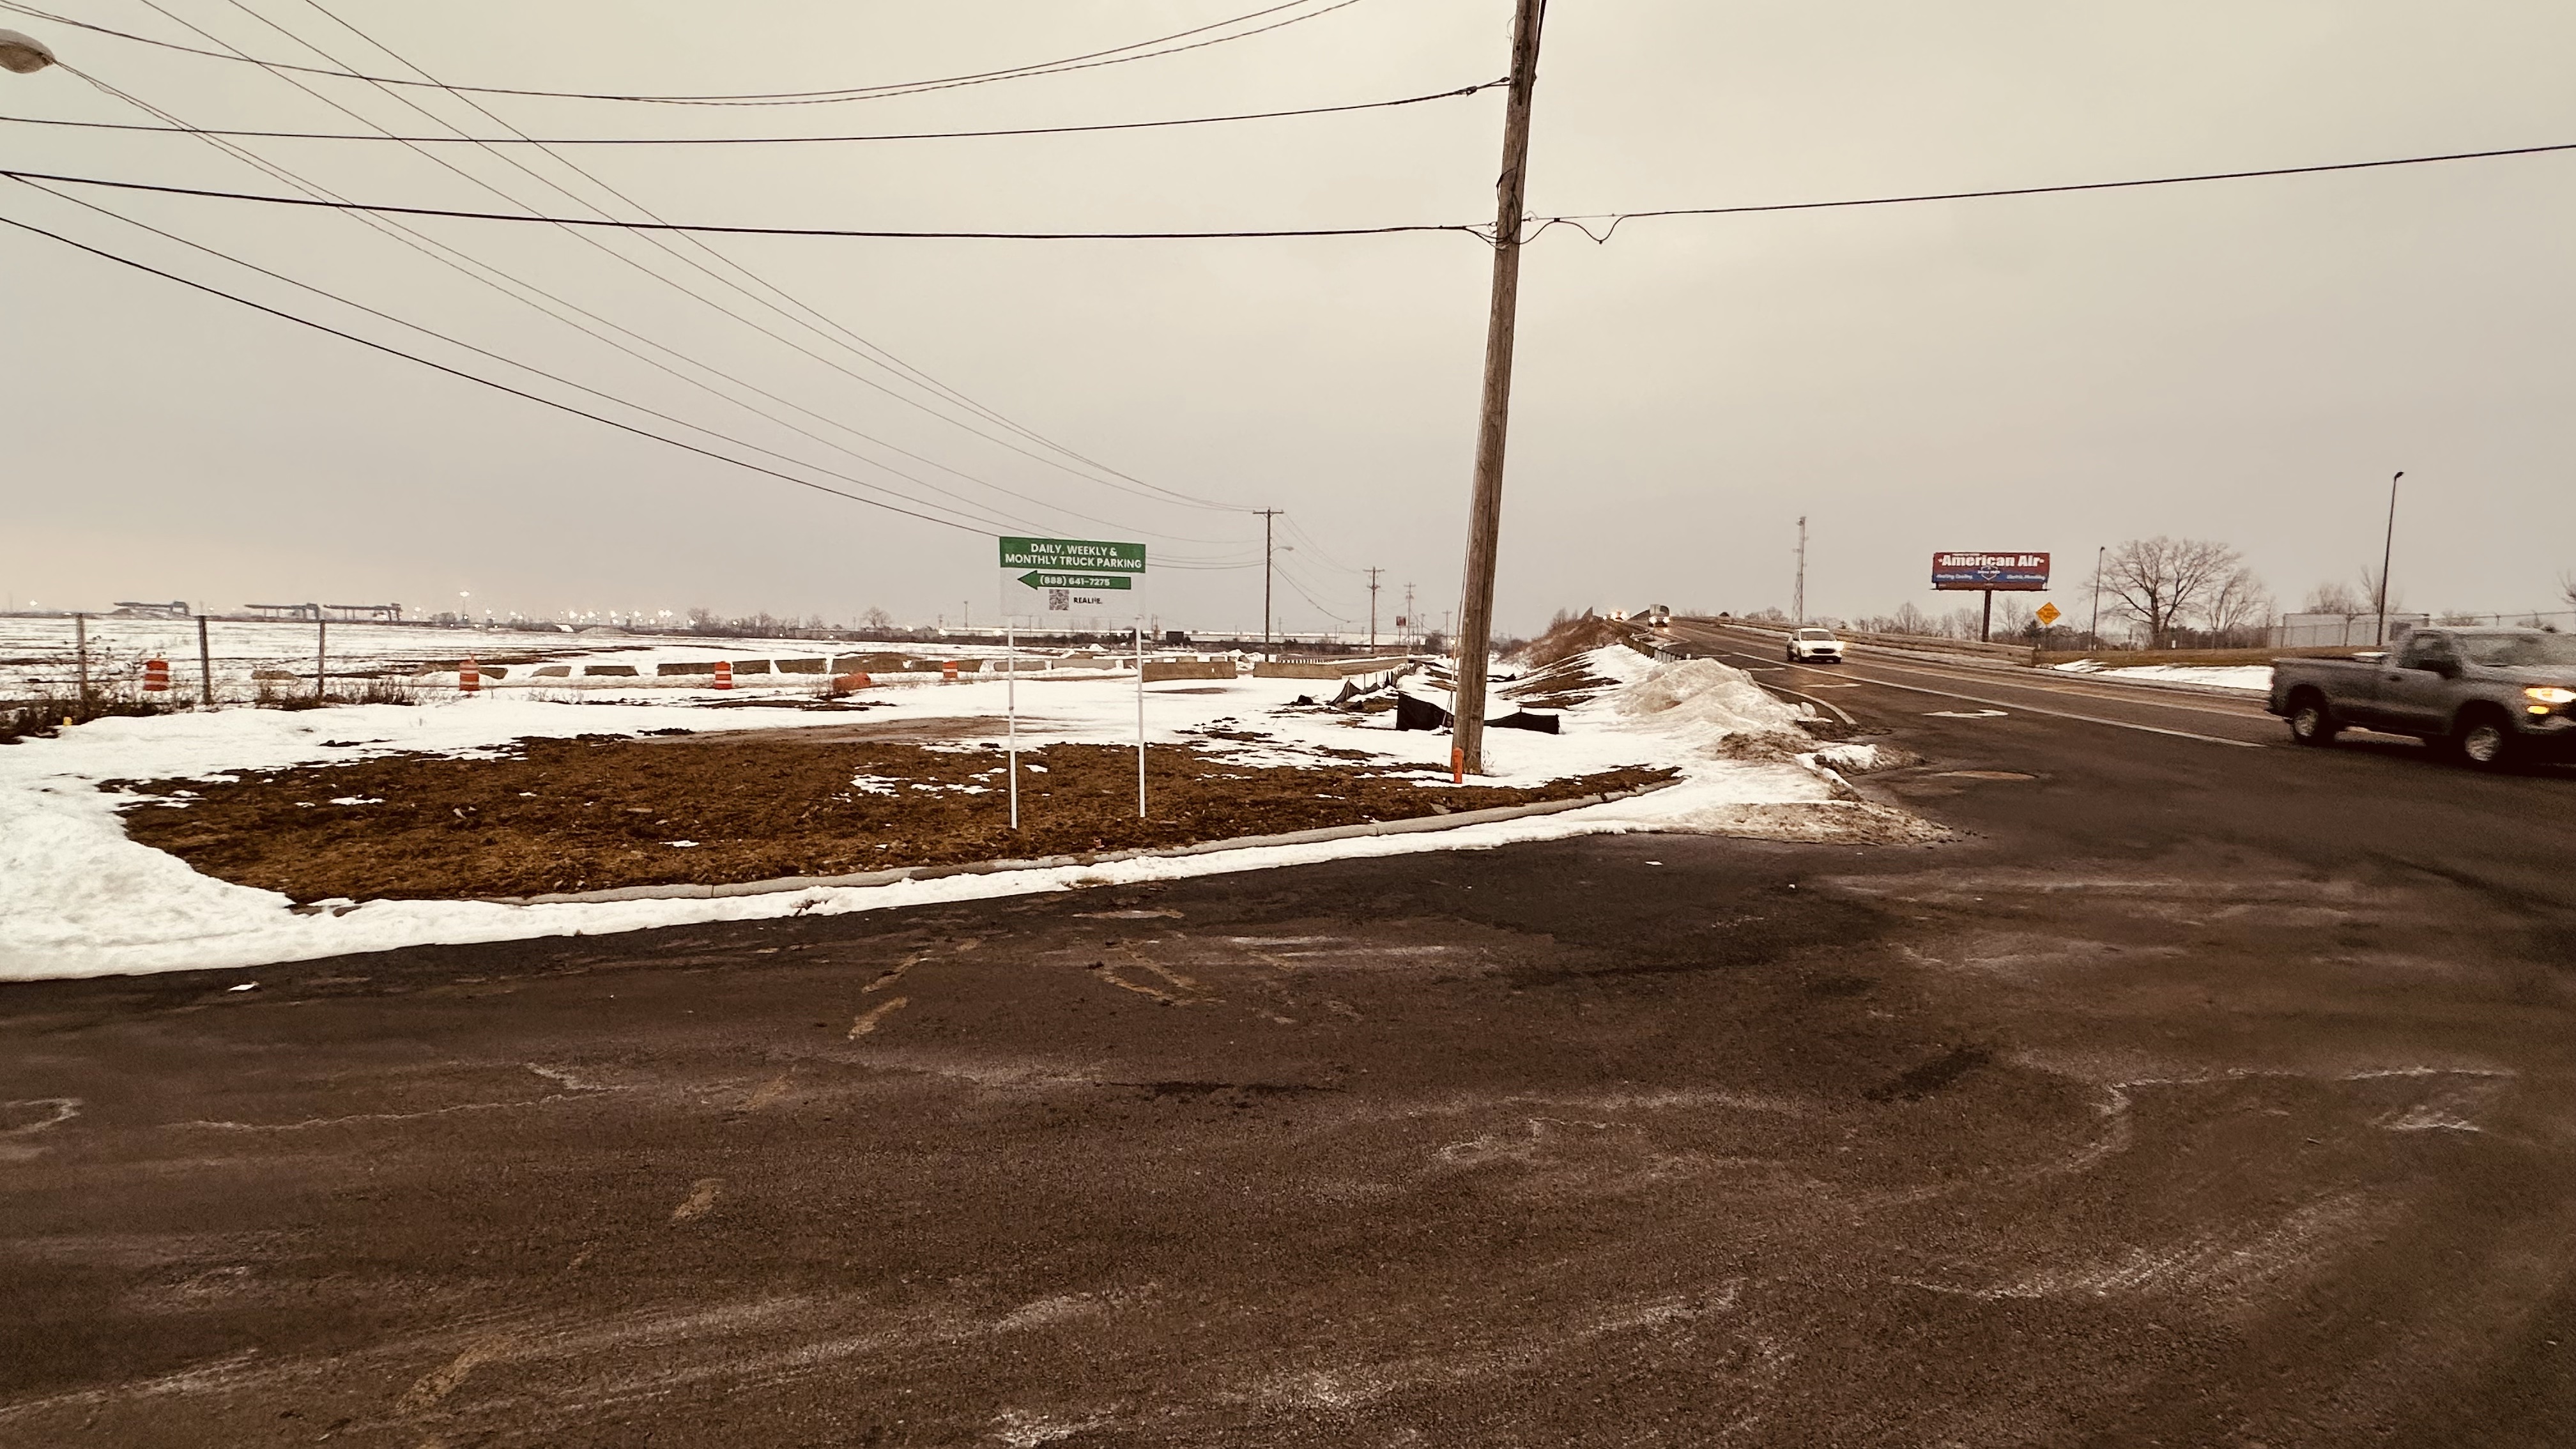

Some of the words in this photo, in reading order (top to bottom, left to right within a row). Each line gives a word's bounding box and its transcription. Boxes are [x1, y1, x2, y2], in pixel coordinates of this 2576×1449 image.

[1031, 544, 1064, 555] DAILY,
[1066, 545, 1108, 556] WEEKLY
[1109, 547, 1118, 556] &
[1005, 553, 1057, 565] MONTHLY
[1060, 556, 1095, 567] TRUCK
[1097, 557, 1142, 569] PARKING
[1942, 555, 2015, 566] American
[2018, 555, 2040, 567] Air
[1039, 576, 1066, 586] (888)
[1069, 577, 1110, 586] 641-7275
